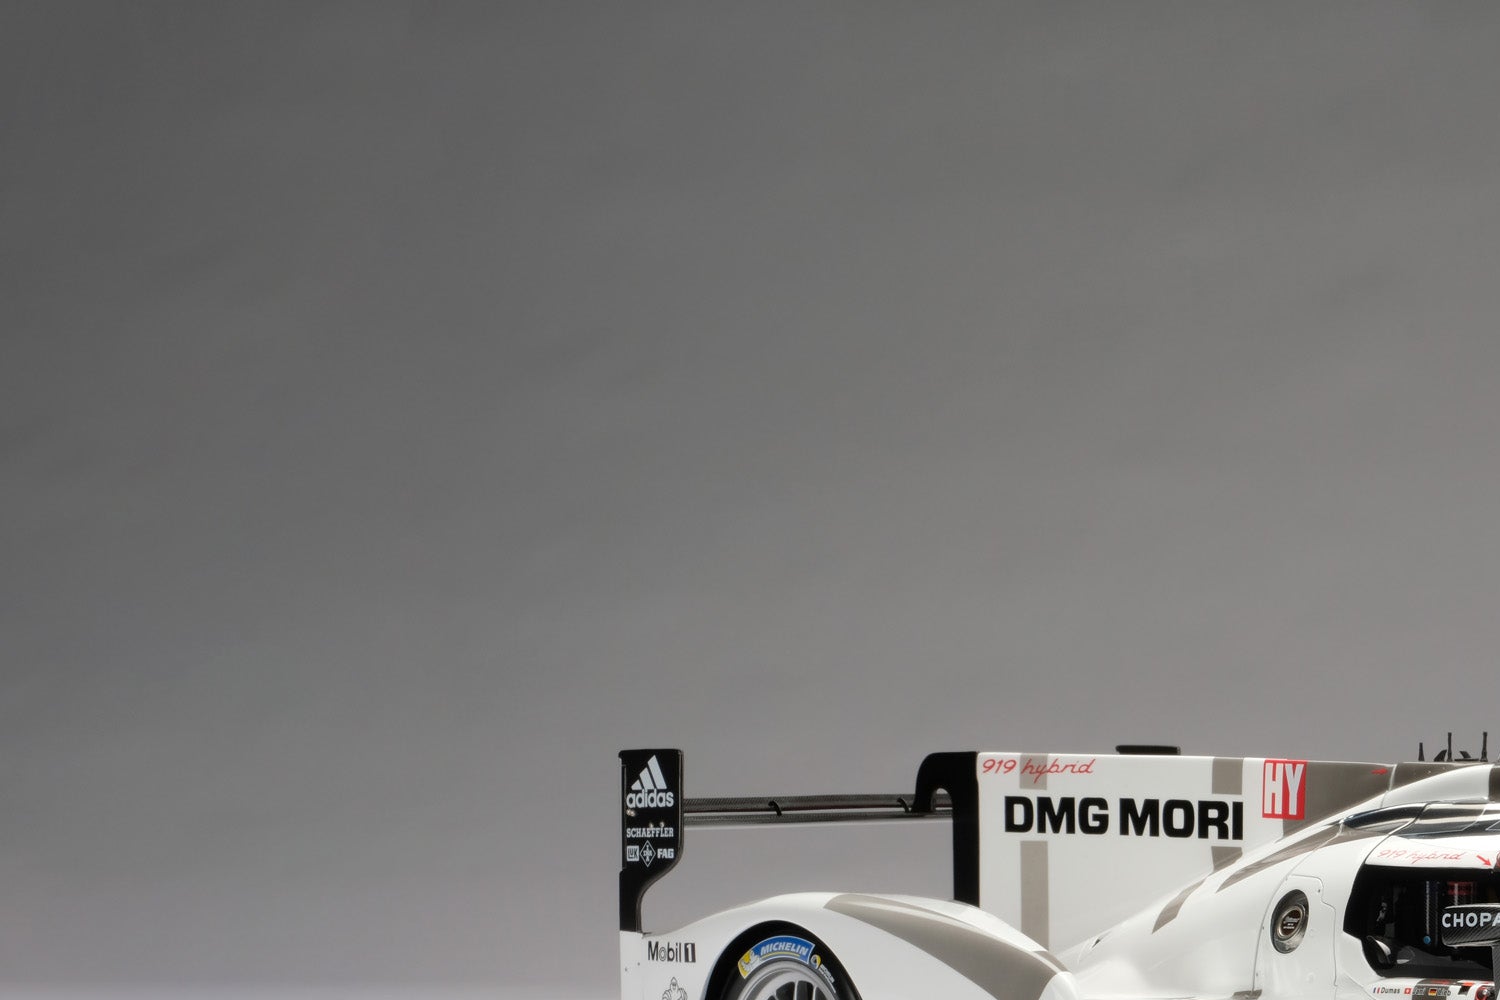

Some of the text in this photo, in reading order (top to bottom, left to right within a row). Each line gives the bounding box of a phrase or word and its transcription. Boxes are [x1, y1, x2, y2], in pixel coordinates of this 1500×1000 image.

[982, 758, 1096, 784] 919 hybrid
[626, 788, 674, 808] adidas
[1263, 762, 1305, 815] HY
[1004, 796, 1243, 840] DMG MORI
[626, 827, 674, 838] SCHAEFFLER
[657, 848, 674, 859] FAG
[648, 940, 682, 962] Mobil
[760, 941, 809, 957] MICHELIN
